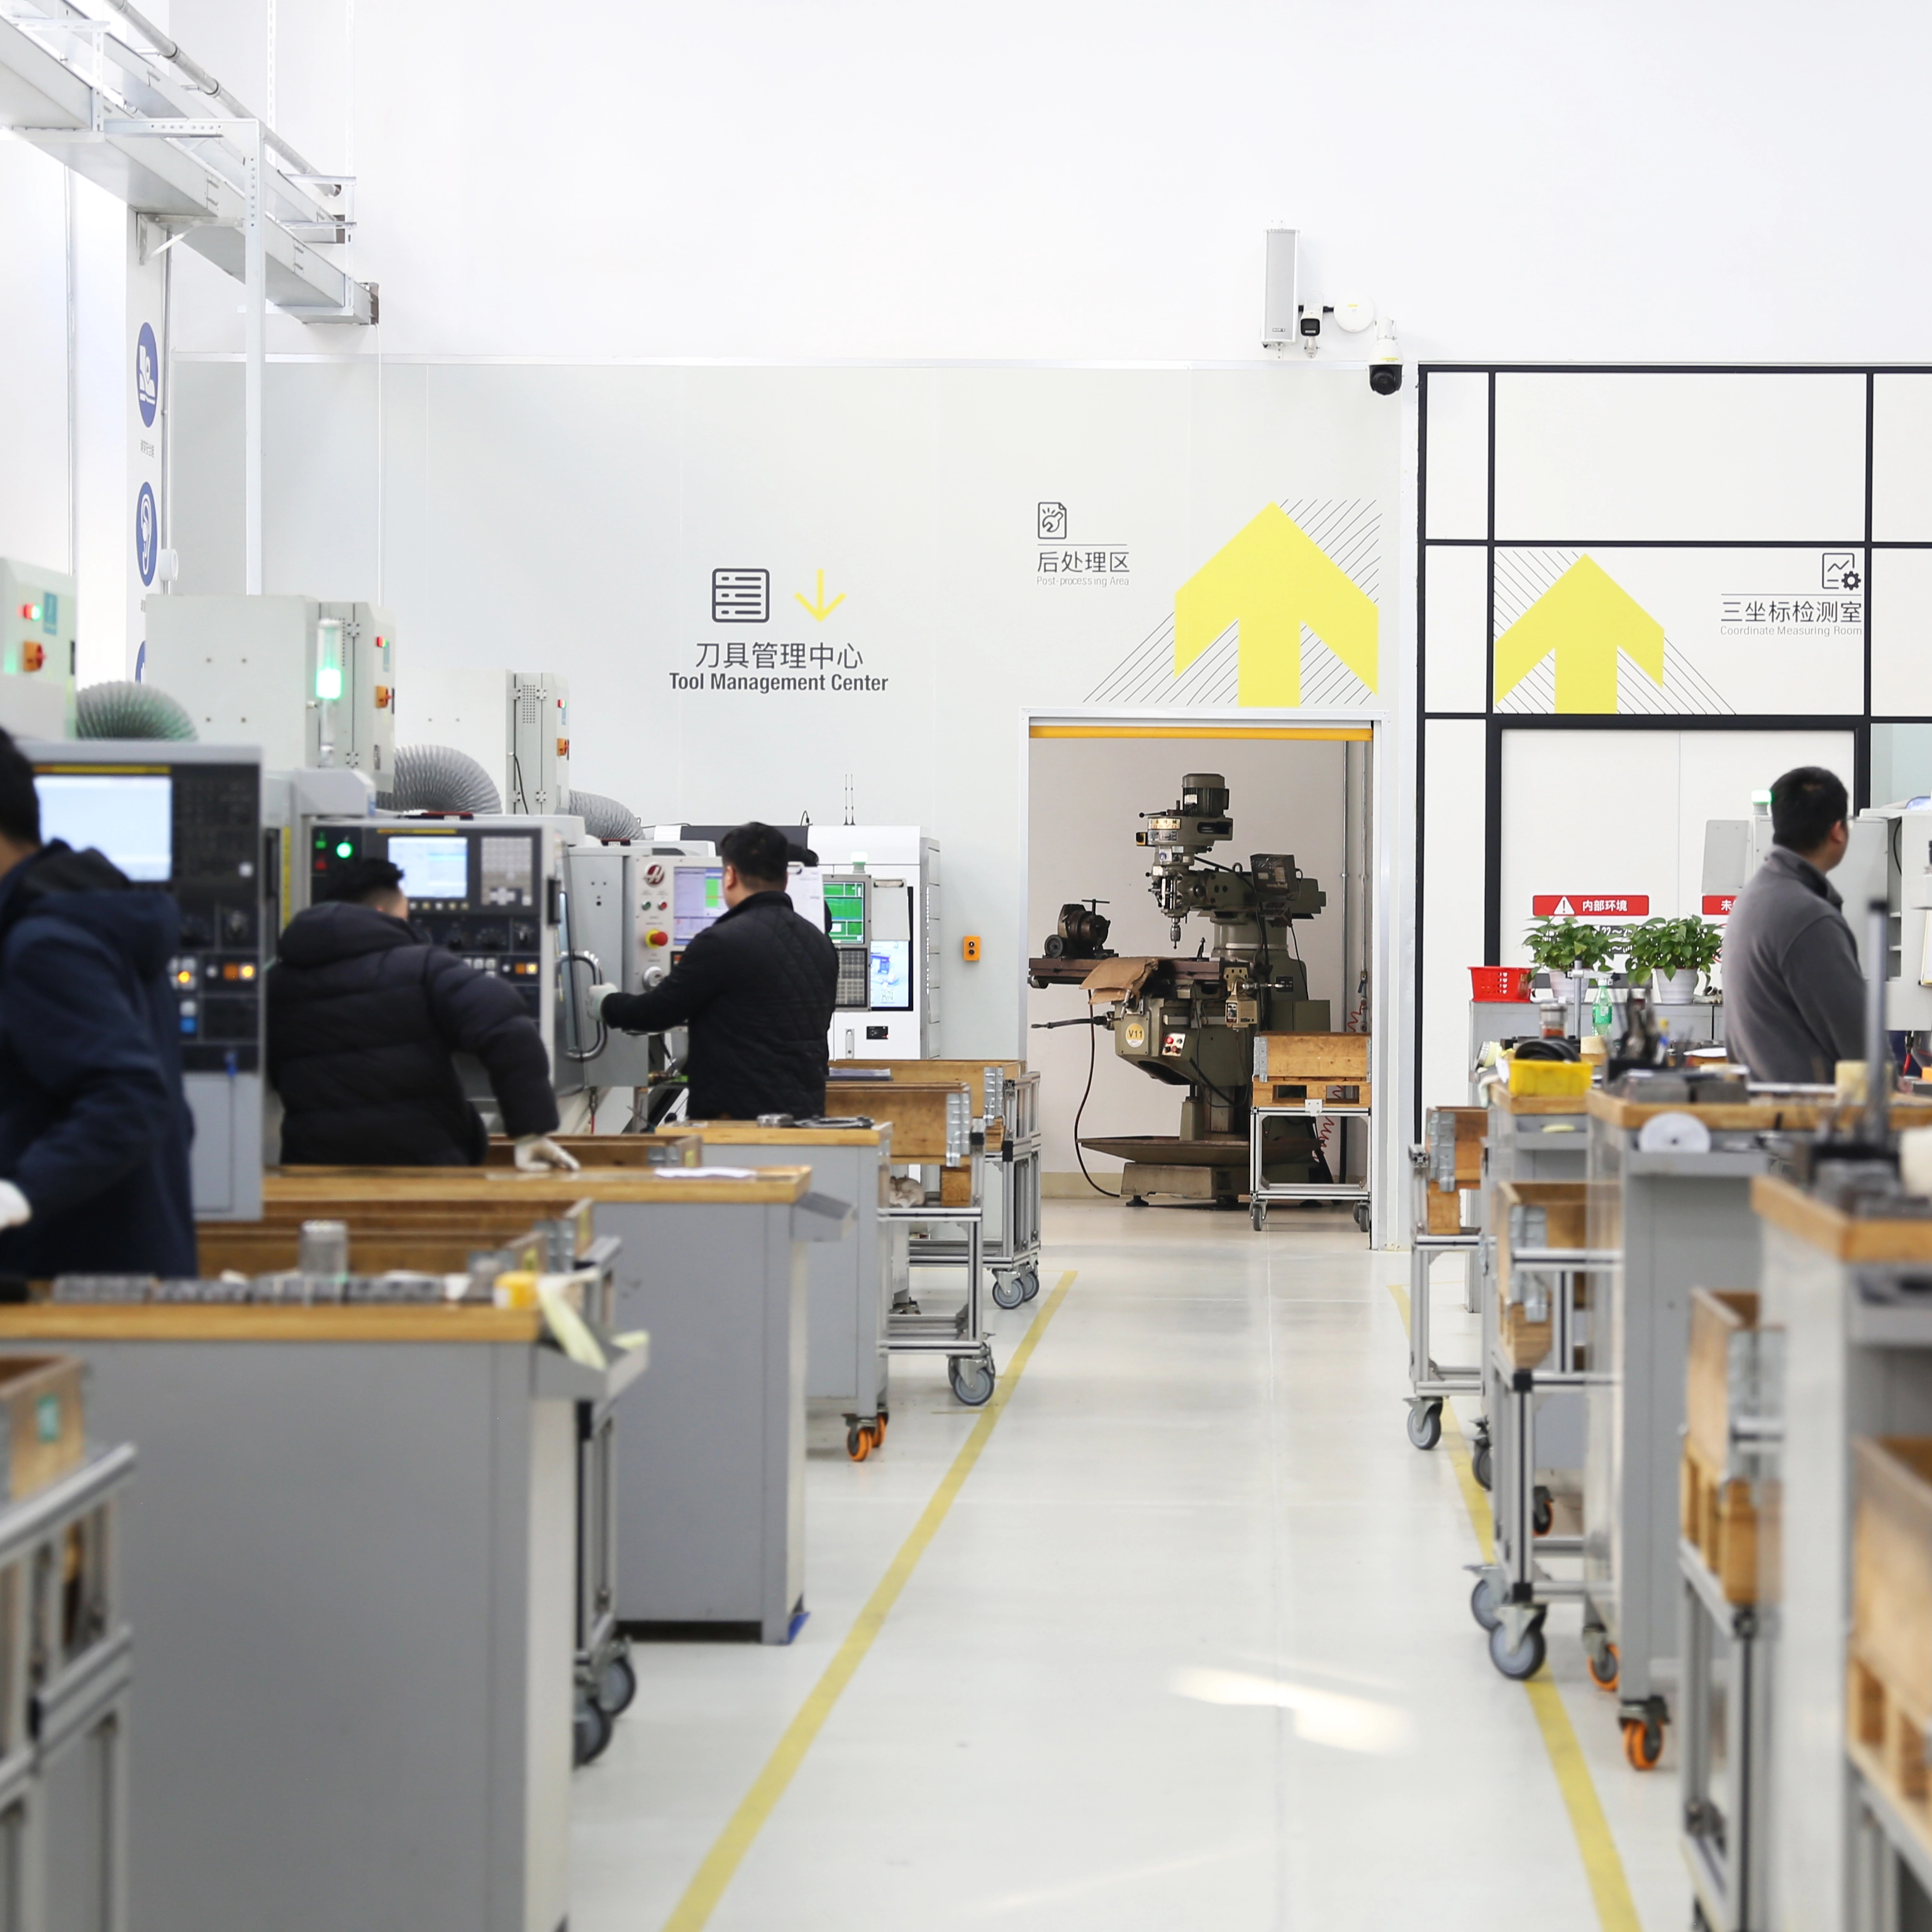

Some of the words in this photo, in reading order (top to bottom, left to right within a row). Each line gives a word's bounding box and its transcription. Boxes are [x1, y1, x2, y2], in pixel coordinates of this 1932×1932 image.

[1037, 550, 1130, 573] 后处理区
[1036, 575, 1107, 587] Post-processing
[1109, 576, 1130, 586] Area
[1721, 600, 1862, 623] 三坐标检测室
[1720, 626, 1775, 635] Coordinate
[1777, 626, 1830, 637] Measuring
[1833, 626, 1862, 636] Room
[695, 641, 863, 670] 刀具管理中心
[669, 672, 704, 690] Tool
[711, 672, 826, 694] Management
[831, 673, 889, 691] Center
[1582, 899, 1628, 912] 内部环境
[1128, 1030, 1143, 1038] V11
